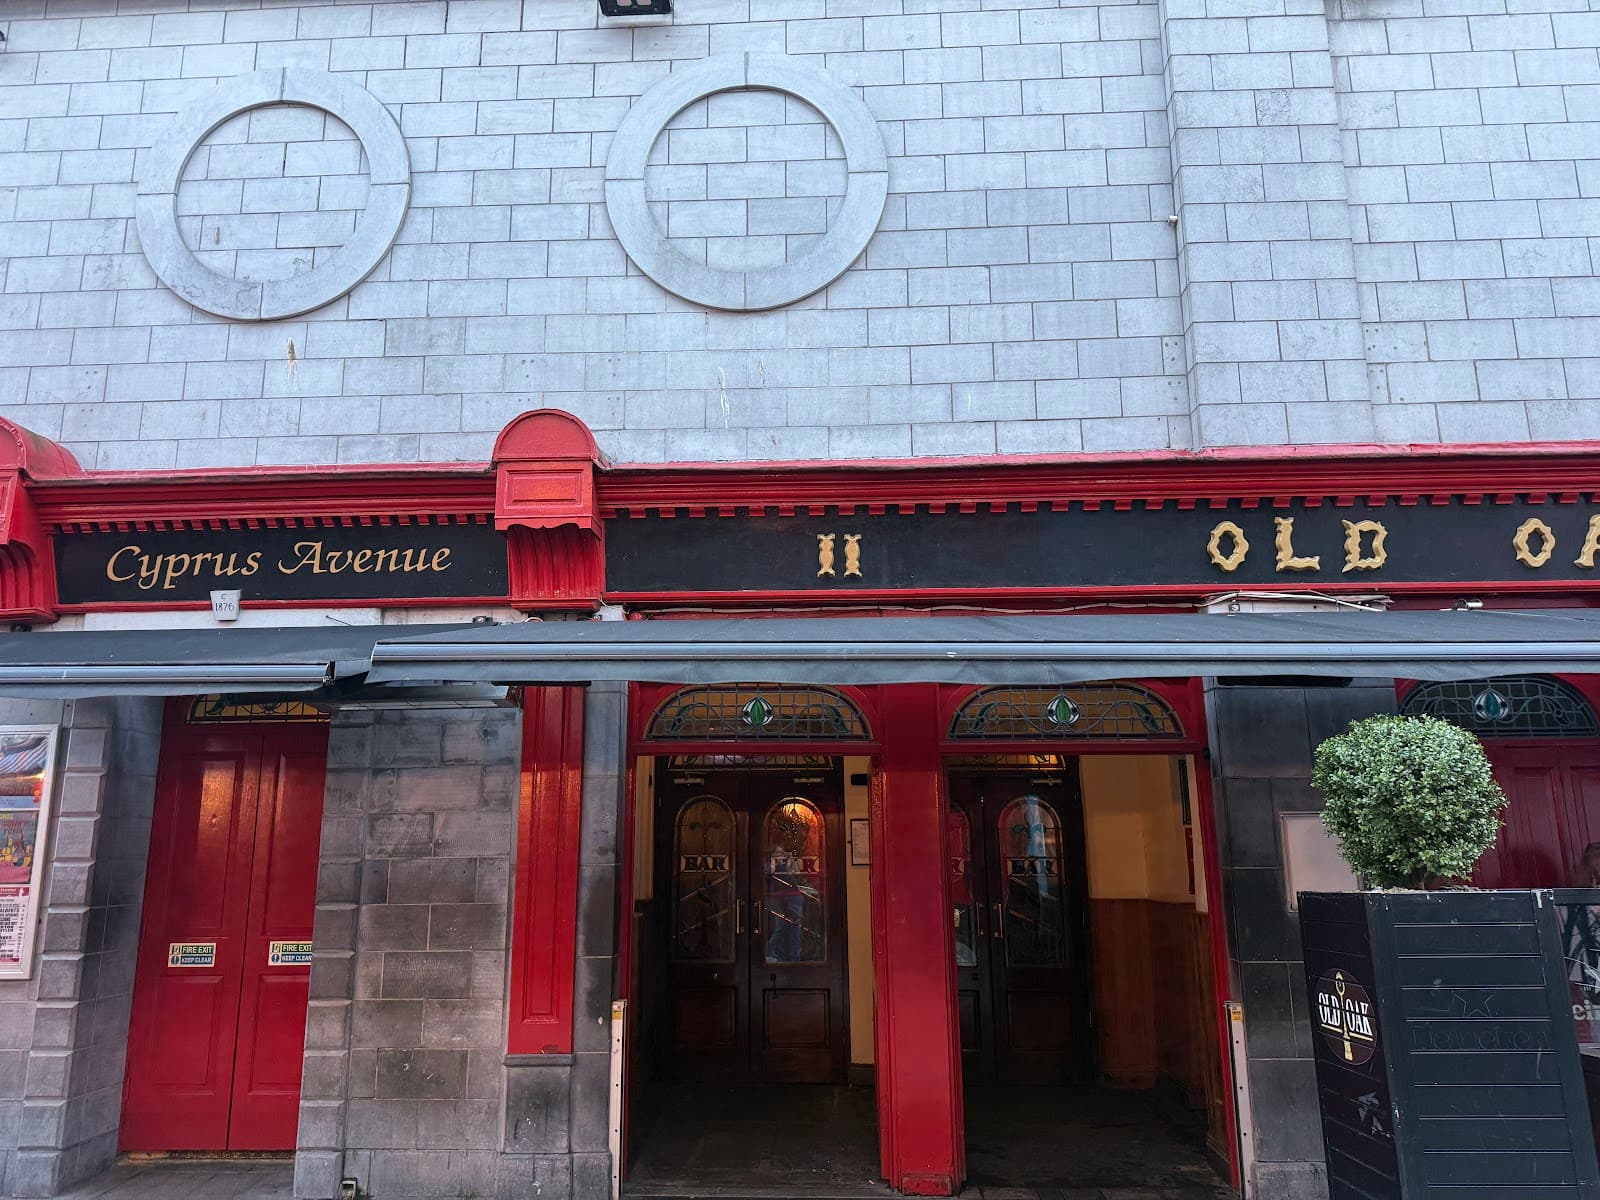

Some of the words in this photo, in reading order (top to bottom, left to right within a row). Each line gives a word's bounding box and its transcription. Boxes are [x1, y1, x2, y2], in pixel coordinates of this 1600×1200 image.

[1206, 516, 1389, 573] OLD
[106, 545, 262, 590] Cyprus
[277, 540, 452, 574] Avenue
[215, 602, 235, 612] 1876
[684, 856, 727, 871] BAR
[182, 946, 197, 954] FIRE
[198, 946, 213, 954] EXIT
[283, 944, 298, 952] FIRE
[298, 944, 312, 952] EXIT
[1318, 992, 1341, 1026] OLD
[1345, 998, 1373, 1036] OAK
